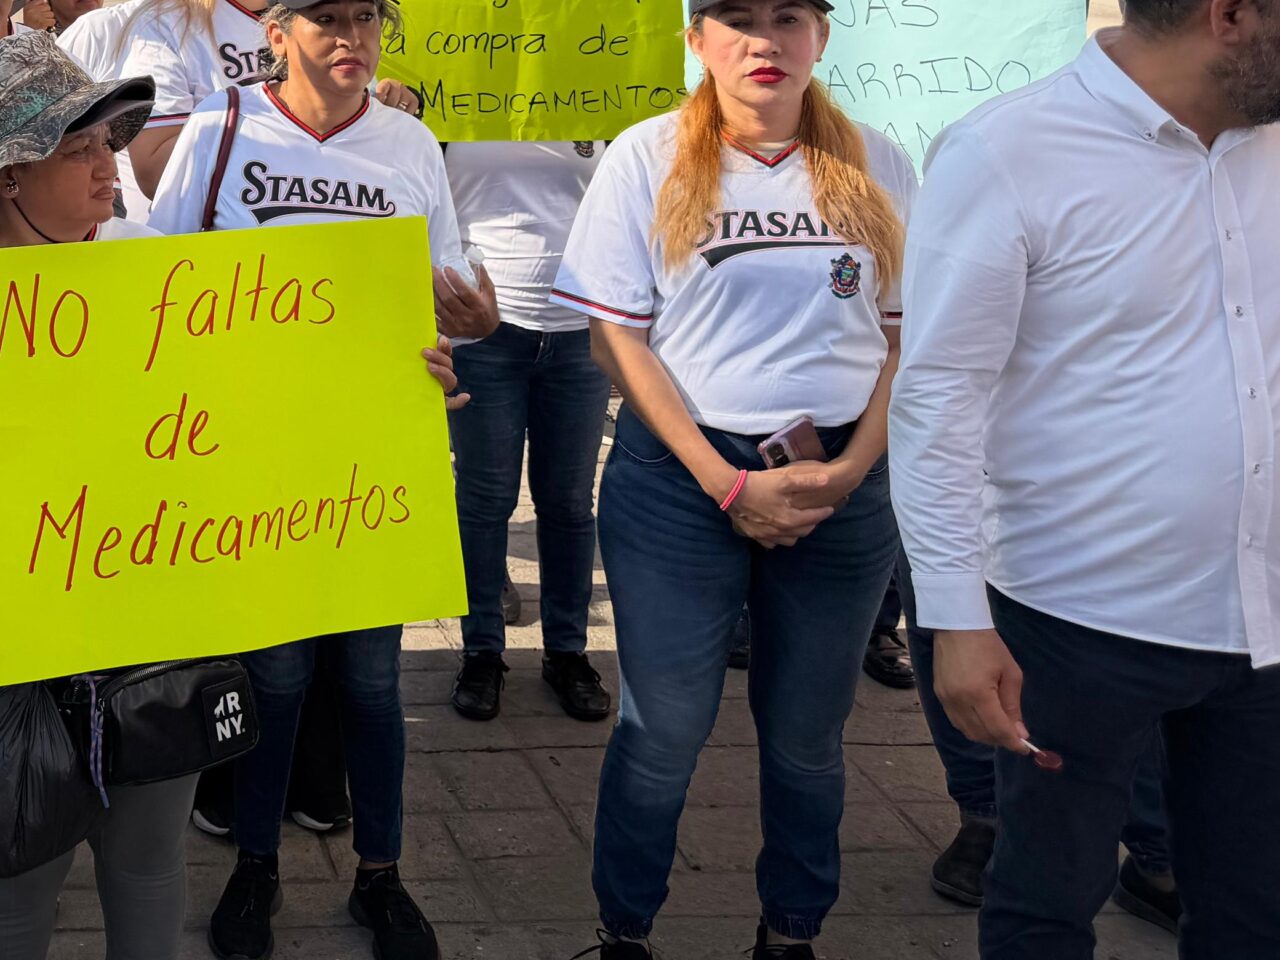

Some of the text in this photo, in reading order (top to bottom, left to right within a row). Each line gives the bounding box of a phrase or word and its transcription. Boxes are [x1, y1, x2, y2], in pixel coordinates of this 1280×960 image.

[426, 31, 546, 69] compra
[579, 24, 629, 57] de
[241, 160, 396, 212] STASAM
[144, 253, 337, 372] faltas
[144, 392, 221, 461] de
[28, 463, 411, 592] Medicamentos
